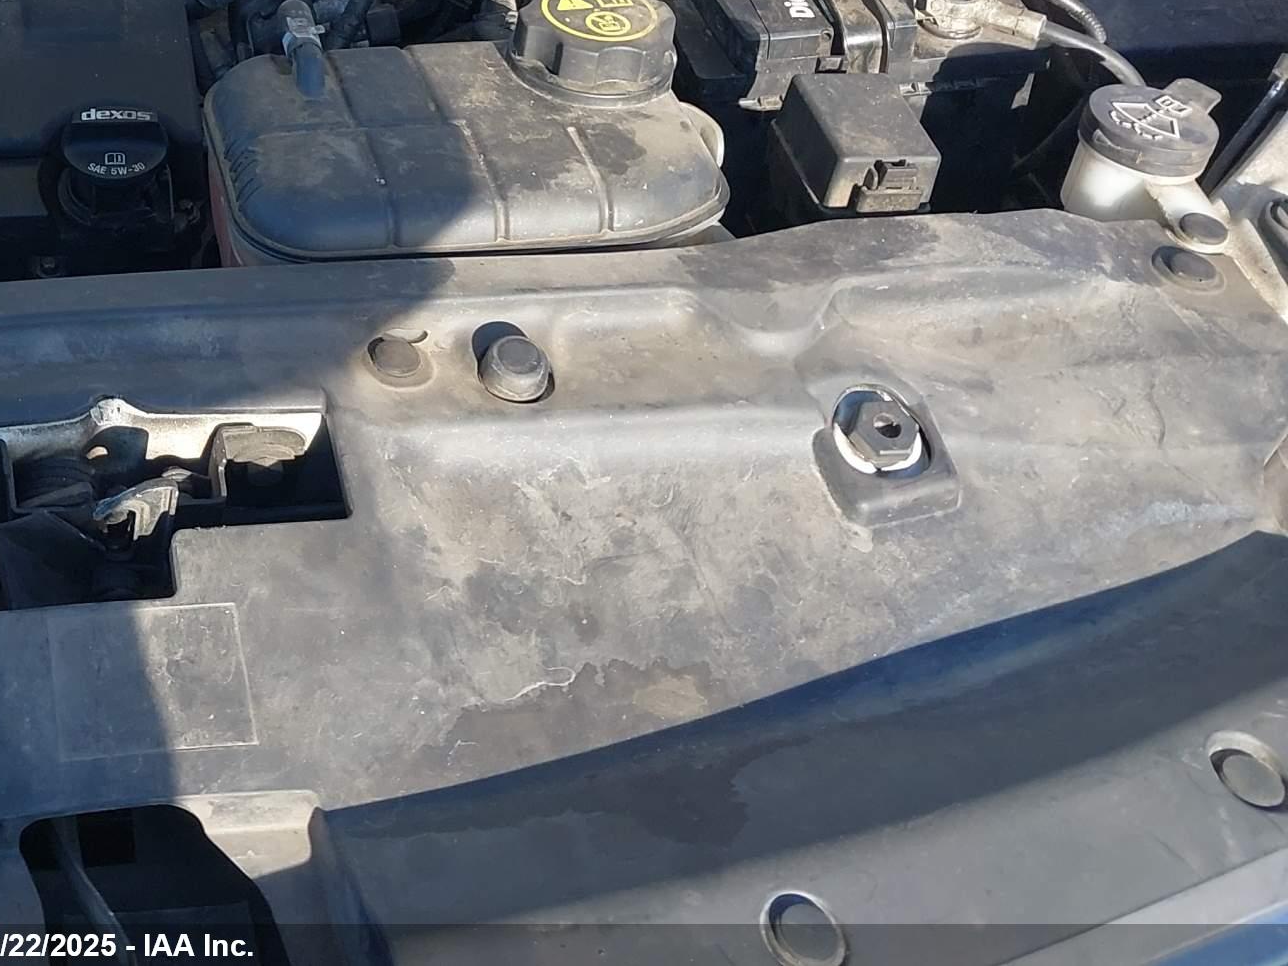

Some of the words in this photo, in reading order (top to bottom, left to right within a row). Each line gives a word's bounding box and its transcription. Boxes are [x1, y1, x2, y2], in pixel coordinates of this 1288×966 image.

[81, 108, 153, 121] dexos
[87, 162, 107, 176] SAE
[111, 162, 146, 176] 5W-30
